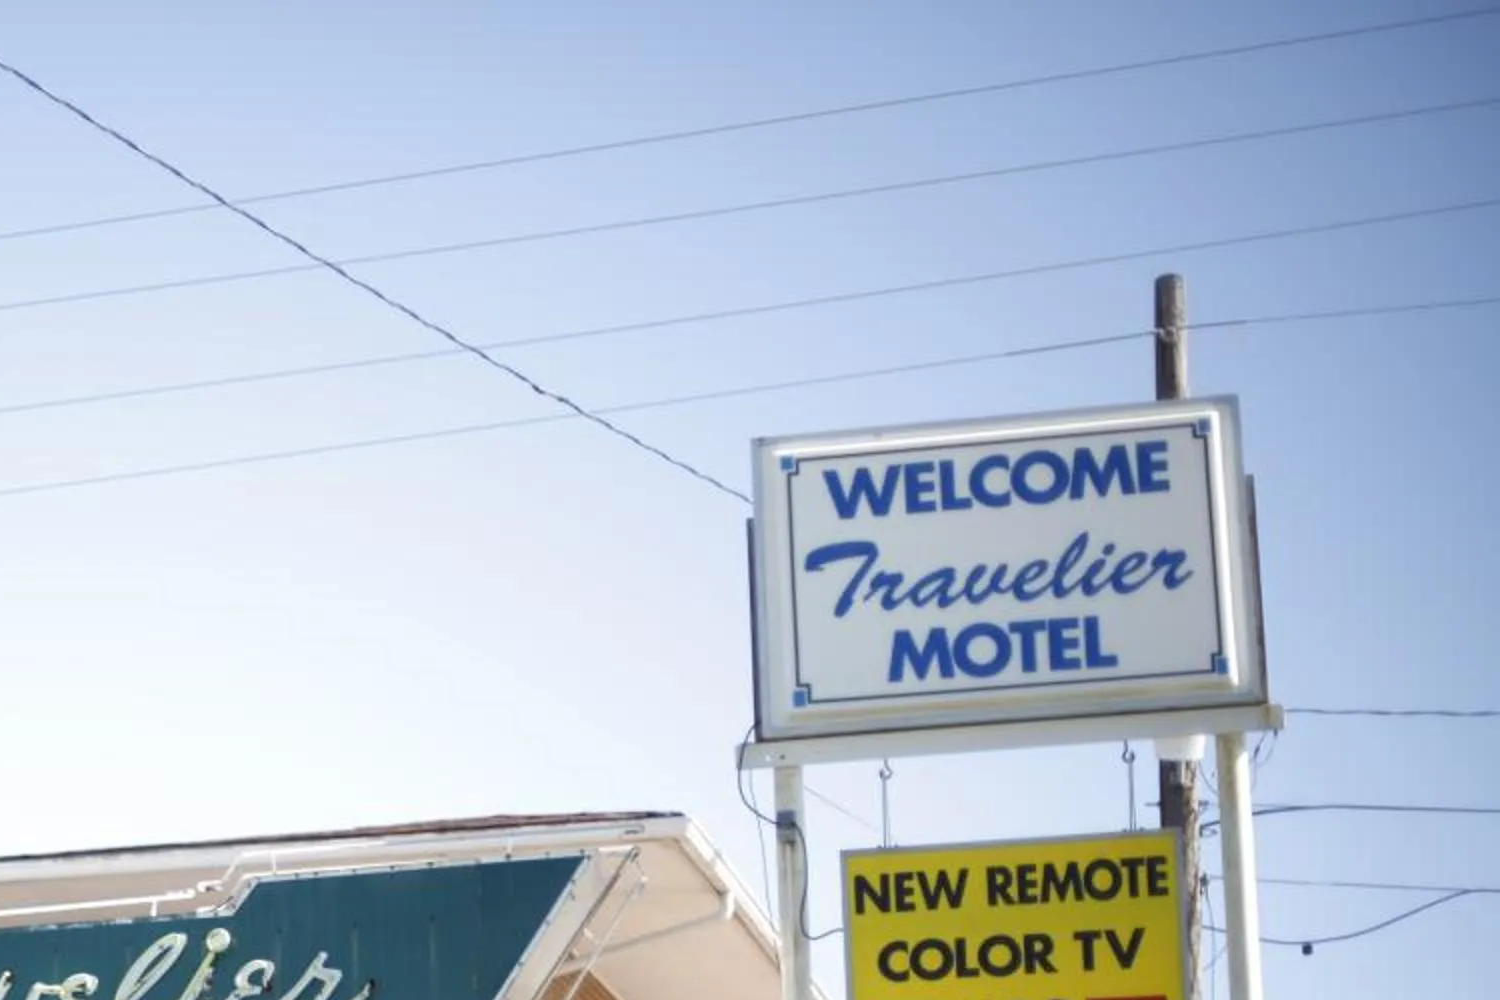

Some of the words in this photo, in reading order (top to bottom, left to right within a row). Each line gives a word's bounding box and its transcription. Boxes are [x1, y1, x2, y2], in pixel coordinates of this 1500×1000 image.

[822, 441, 1170, 519] WELCOME
[804, 531, 1193, 617] Travelier
[888, 616, 1117, 682] MOTEL
[854, 869, 969, 915] NEW
[986, 856, 1169, 906] REMOTE
[878, 933, 1057, 982] COLOR
[1074, 928, 1145, 971] TV
